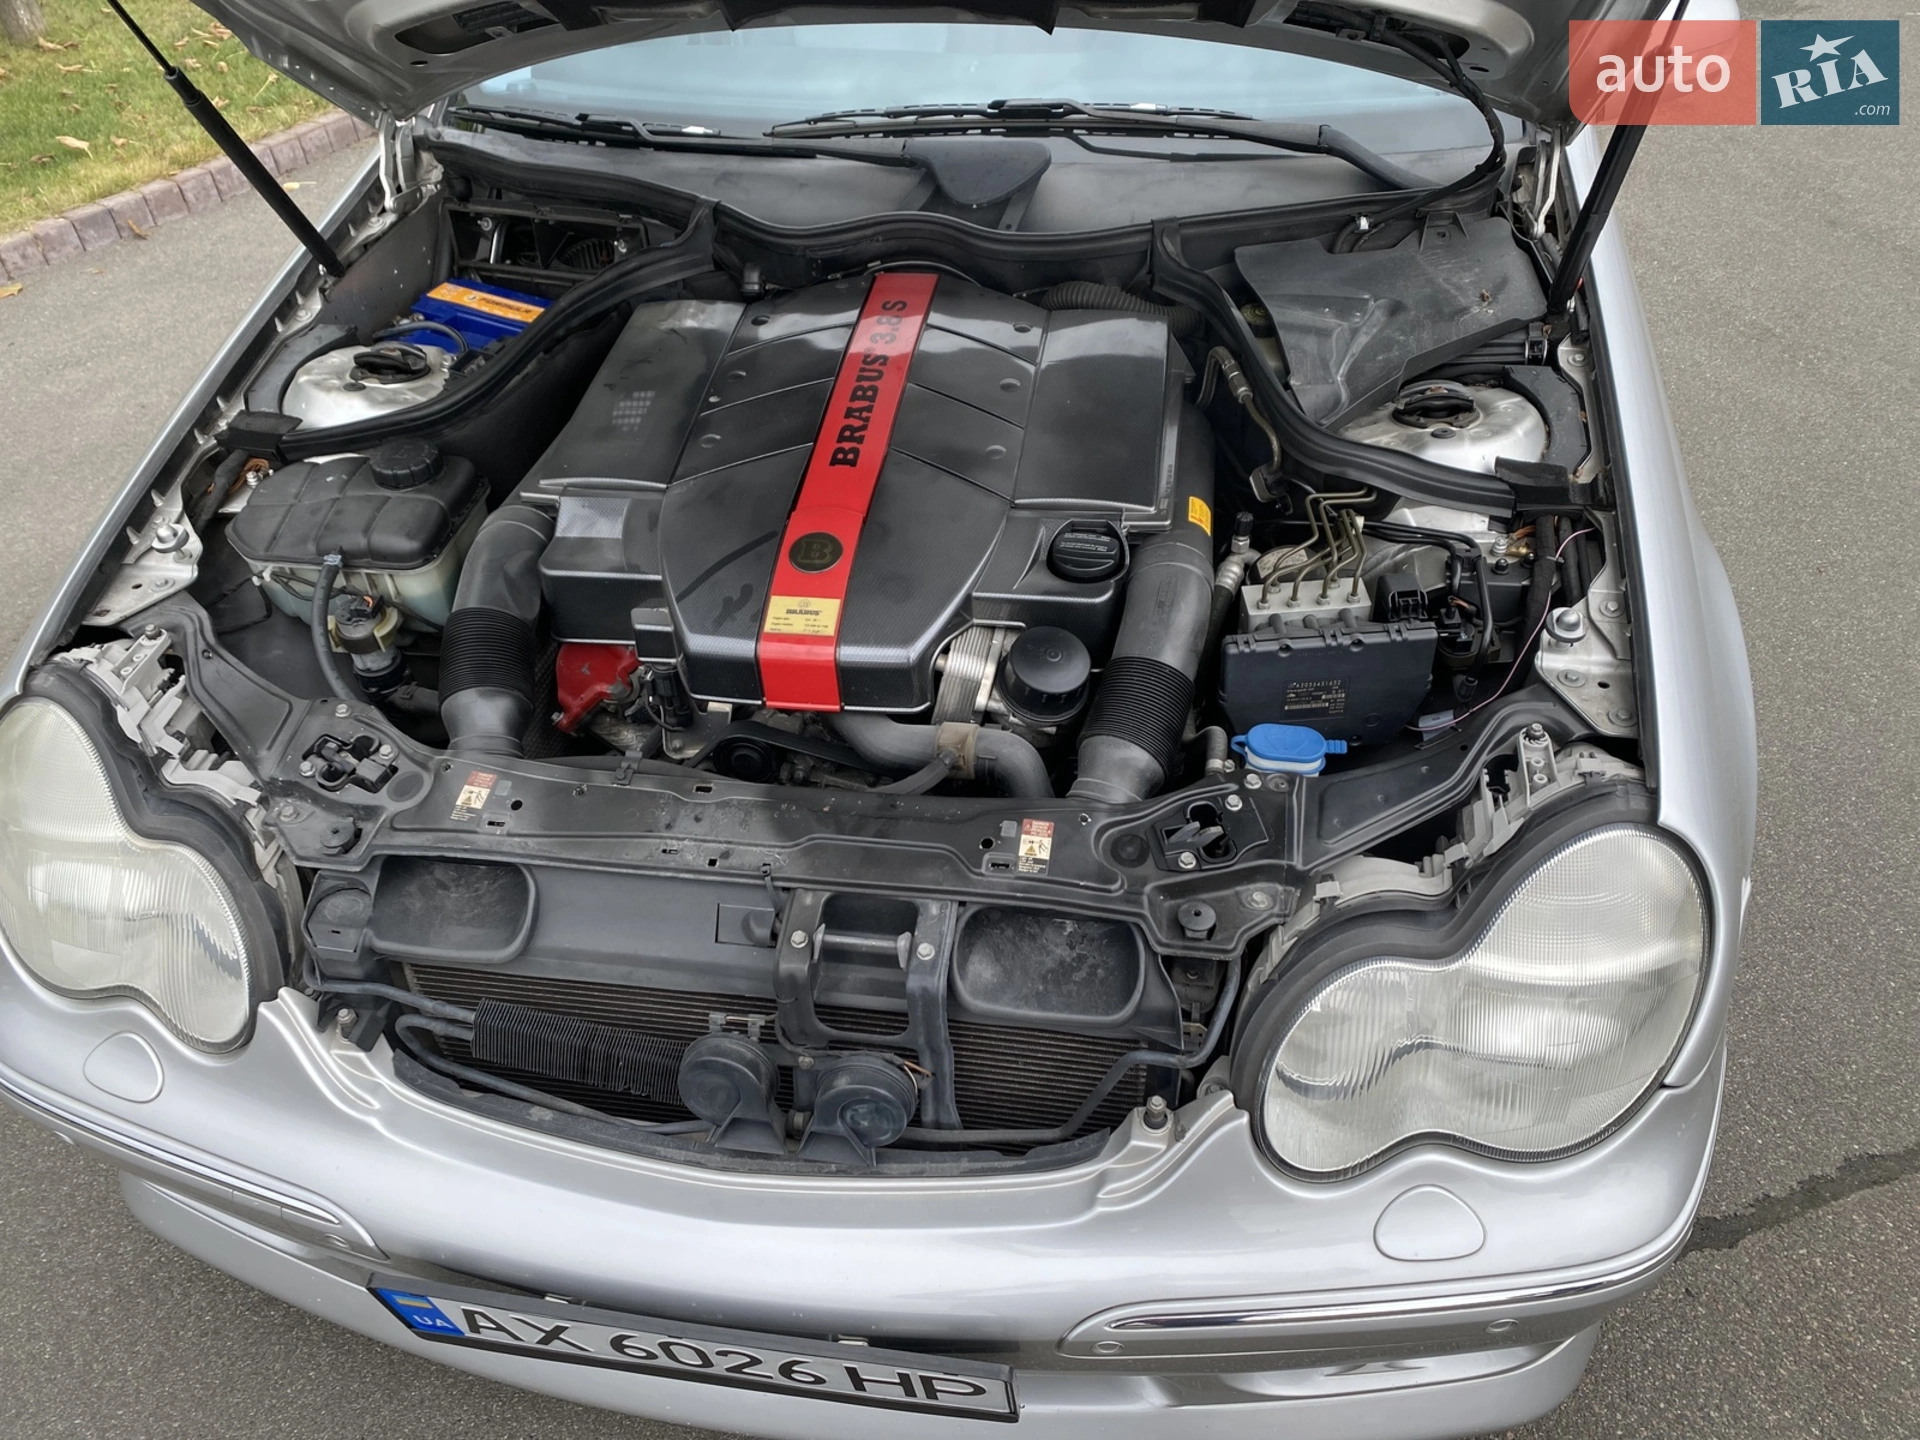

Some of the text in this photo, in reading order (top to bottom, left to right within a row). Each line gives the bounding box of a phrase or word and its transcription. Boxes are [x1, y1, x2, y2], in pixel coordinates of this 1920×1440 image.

[829, 299, 908, 468] BRABUS 3.8 S
[412, 1314, 454, 1330] UA
[460, 1305, 987, 1401] AX 6026 HP
